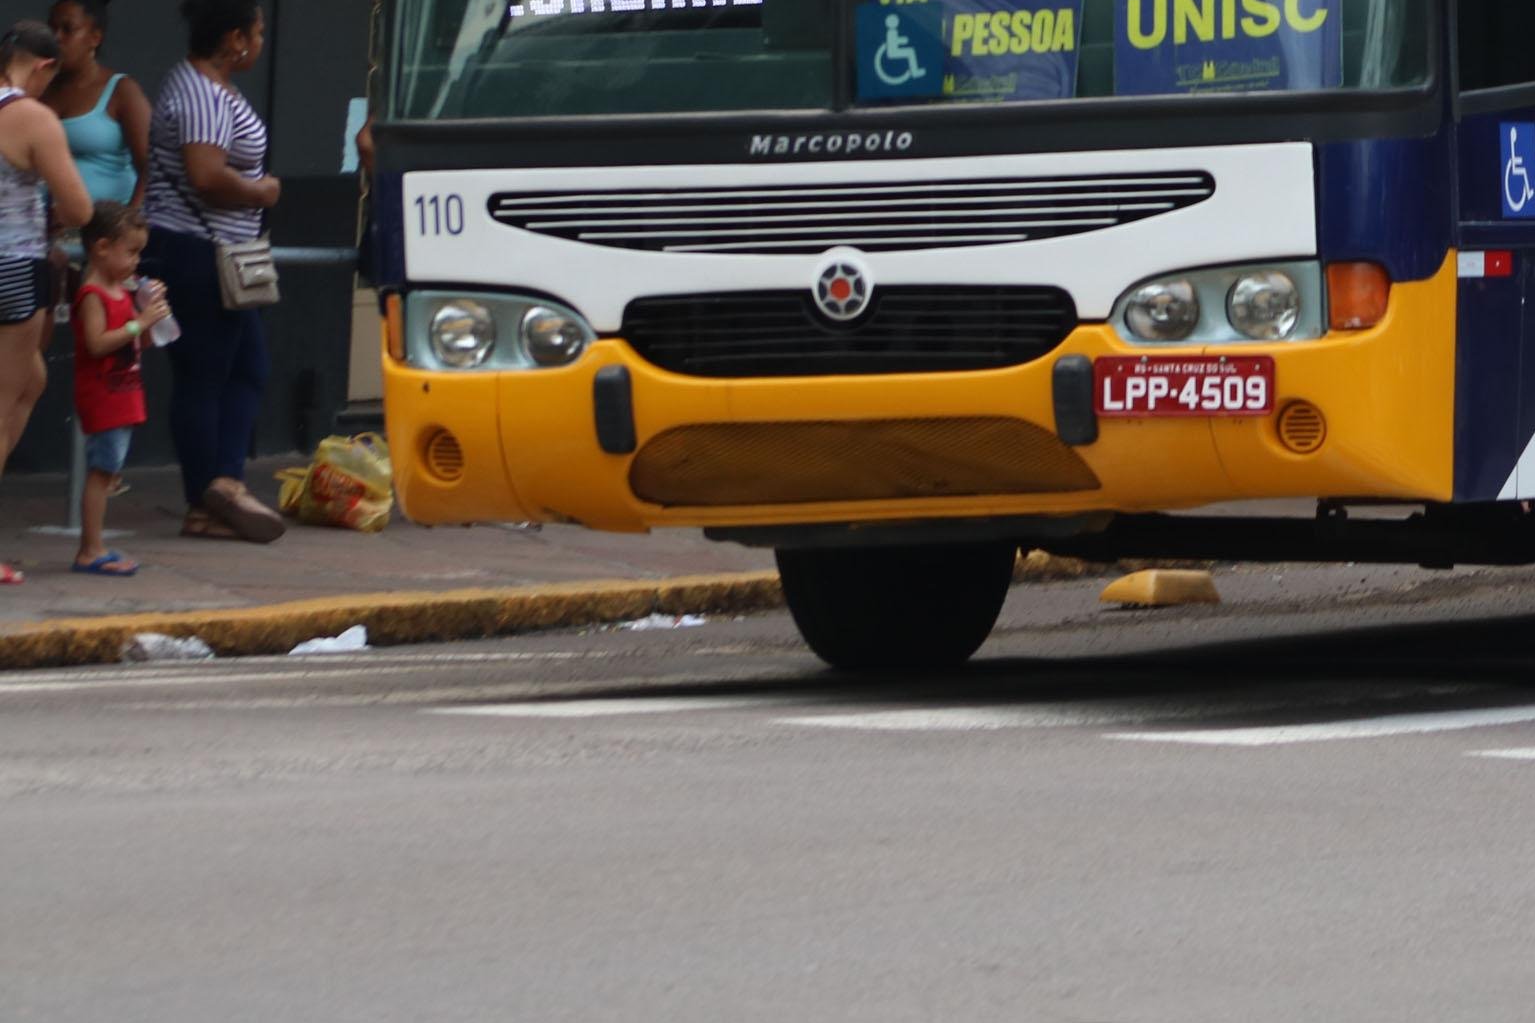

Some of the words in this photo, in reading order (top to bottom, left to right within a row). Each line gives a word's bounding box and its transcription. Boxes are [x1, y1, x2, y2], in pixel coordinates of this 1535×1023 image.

[950, 8, 1075, 58] PESSOA
[749, 131, 914, 154] Marcopolo
[414, 194, 464, 236] 110
